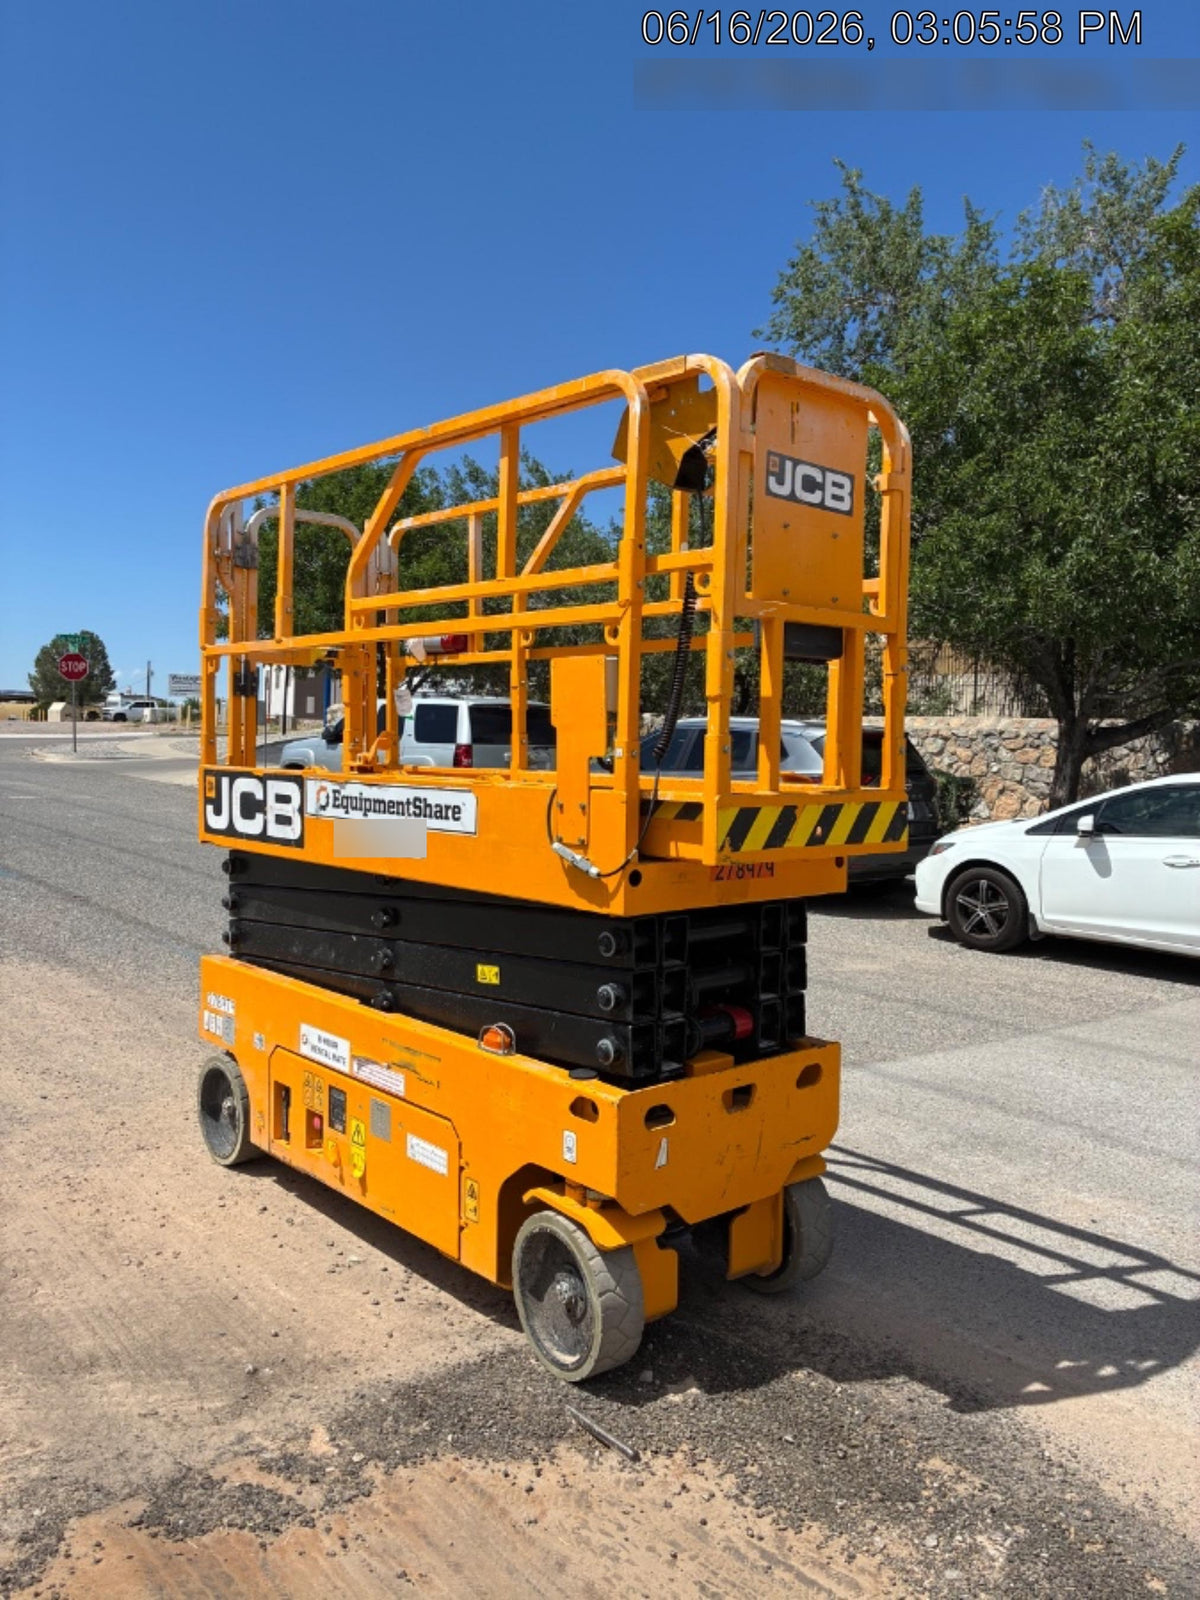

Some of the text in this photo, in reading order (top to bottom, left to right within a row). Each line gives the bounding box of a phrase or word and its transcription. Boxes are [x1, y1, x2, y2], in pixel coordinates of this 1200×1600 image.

[768, 459, 852, 511] JCB
[61, 660, 86, 673] STOP
[205, 776, 302, 840] JCB
[332, 789, 462, 822] EquipmentShare
